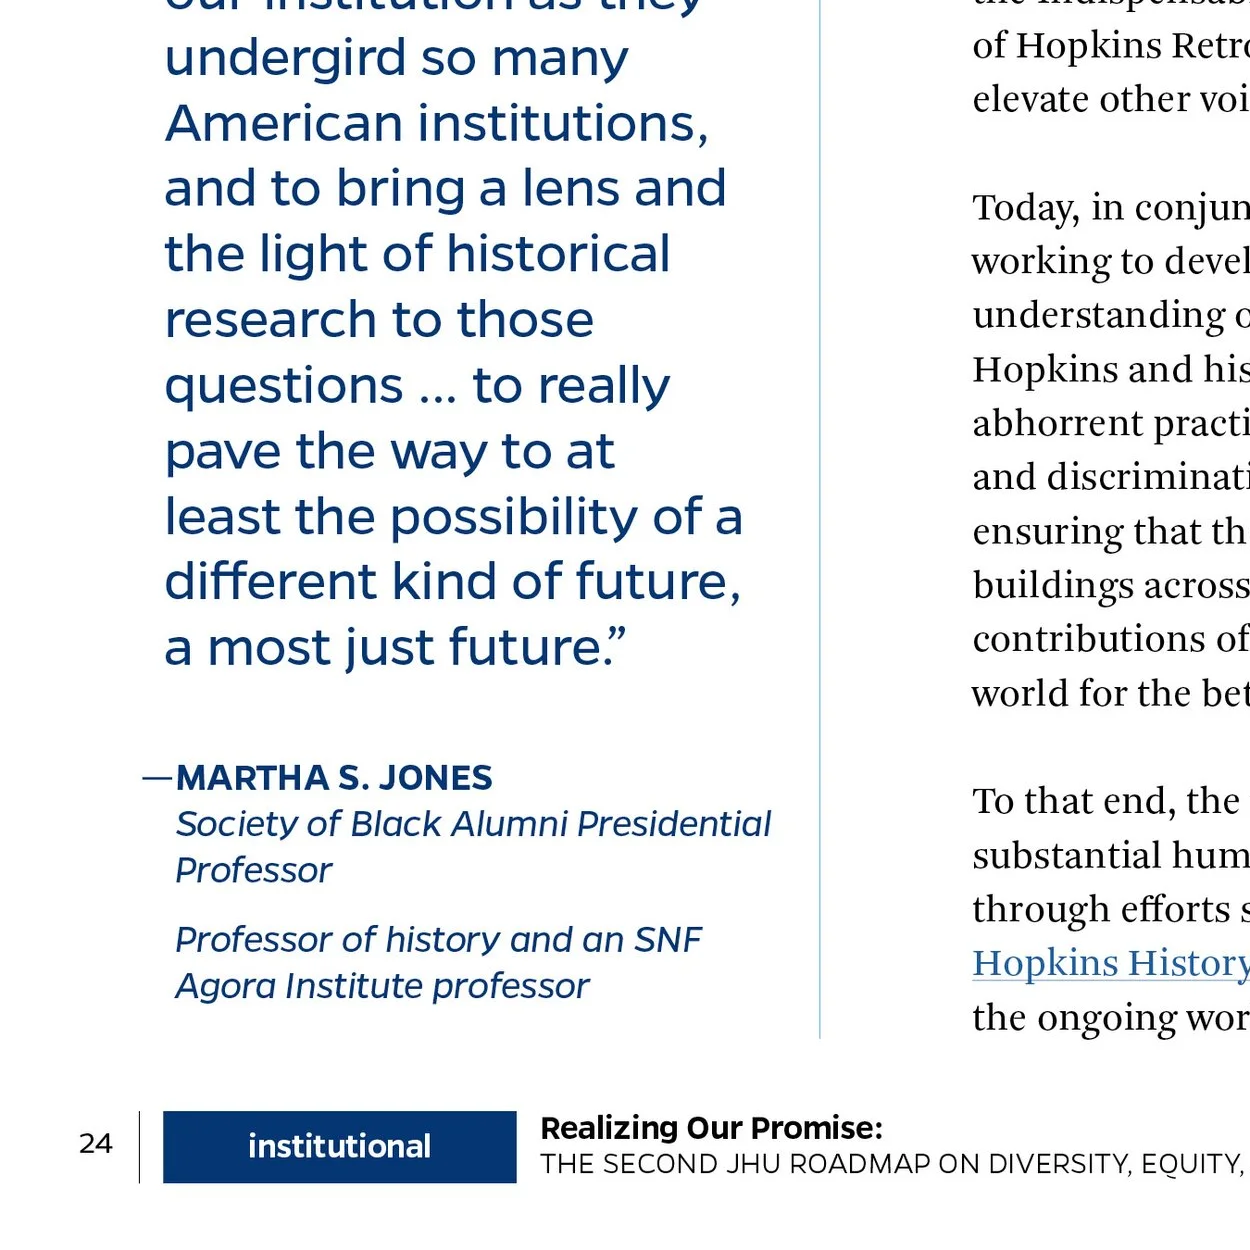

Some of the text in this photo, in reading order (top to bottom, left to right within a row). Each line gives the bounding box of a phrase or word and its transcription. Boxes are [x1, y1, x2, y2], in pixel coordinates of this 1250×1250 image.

[164, 102, 708, 149] American institutions,
[164, 231, 669, 282] the light of historical
[972, 298, 1227, 338] understanding
[165, 364, 672, 413] questions ... to really
[167, 494, 742, 544] least the possibility of a
[165, 625, 626, 675] a most just future.”
[338, 764, 370, 791] S.
[378, 764, 493, 791] JONES
[175, 808, 772, 842] Society of Black Alumni Presidential
[175, 854, 334, 884] Professor
[972, 893, 1111, 933] through
[1121, 892, 1231, 924] efforts
[175, 924, 704, 957] Professor of history and an SNF
[972, 946, 1119, 986] Hopkins
[173, 970, 592, 1006] Agora Institute professor
[972, 1001, 1026, 1032] the
[1037, 1001, 1179, 1041] ongoing
[79, 1132, 114, 1154] 24
[249, 1131, 431, 1158] institutional
[541, 1113, 883, 1145] Realizing Our Promise:
[539, 1152, 594, 1174] THE
[603, 1152, 718, 1174] SECOND
[726, 1152, 780, 1174] JHU
[790, 1152, 931, 1174] ROADMAP
[938, 1153, 979, 1174] ON
[990, 1152, 1132, 1178] DIVERSITY,
[1142, 1152, 1245, 1180] EQUITY,
